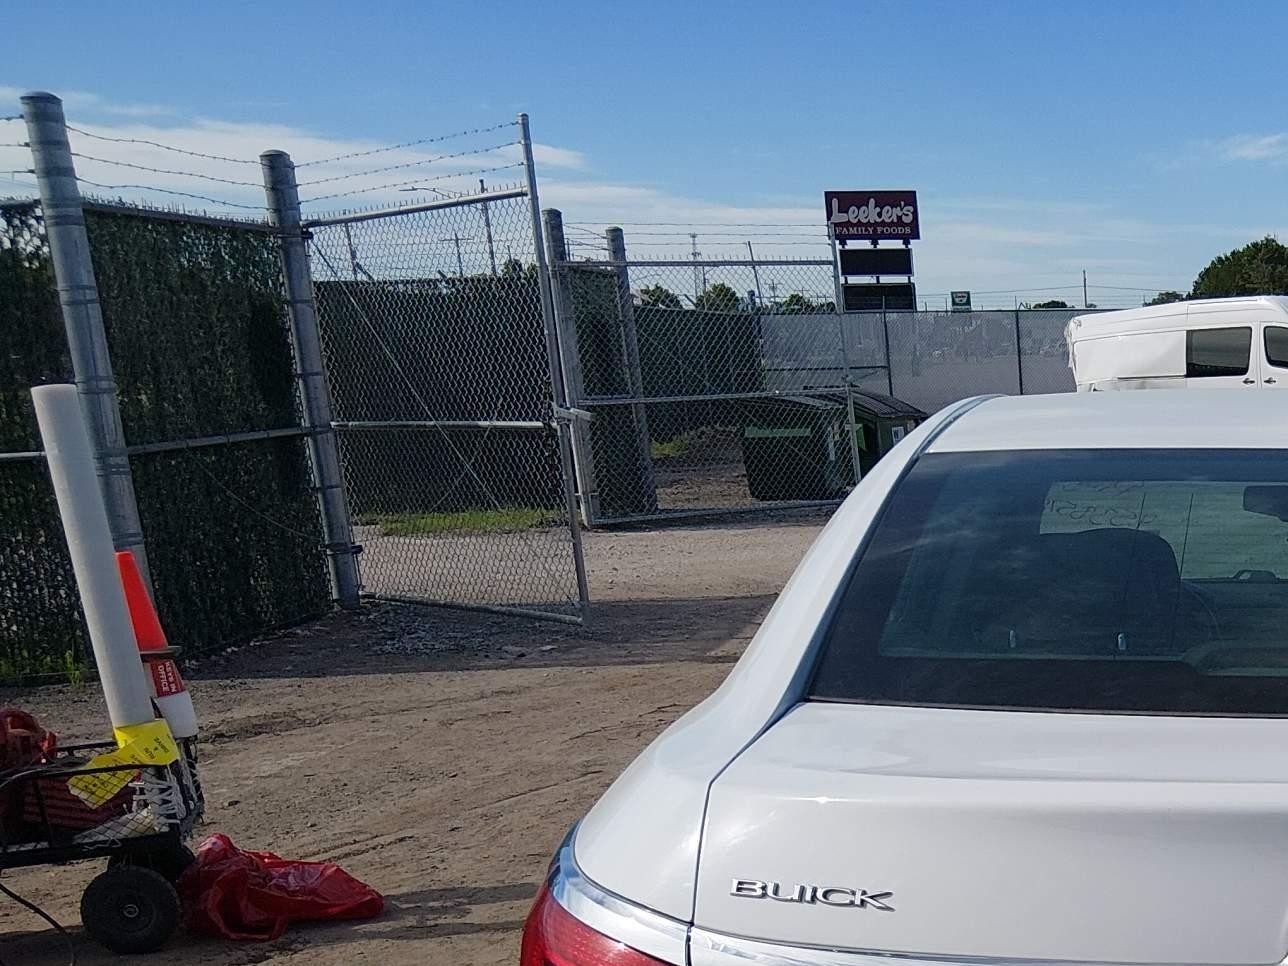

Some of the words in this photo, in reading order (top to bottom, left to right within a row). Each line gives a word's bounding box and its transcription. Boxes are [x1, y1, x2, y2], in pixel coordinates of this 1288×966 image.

[831, 198, 914, 223] Leeker's
[835, 227, 874, 235] FAMILY
[877, 226, 911, 234] FOODS
[158, 664, 170, 692] OFFICE
[730, 878, 896, 912] BUICK
